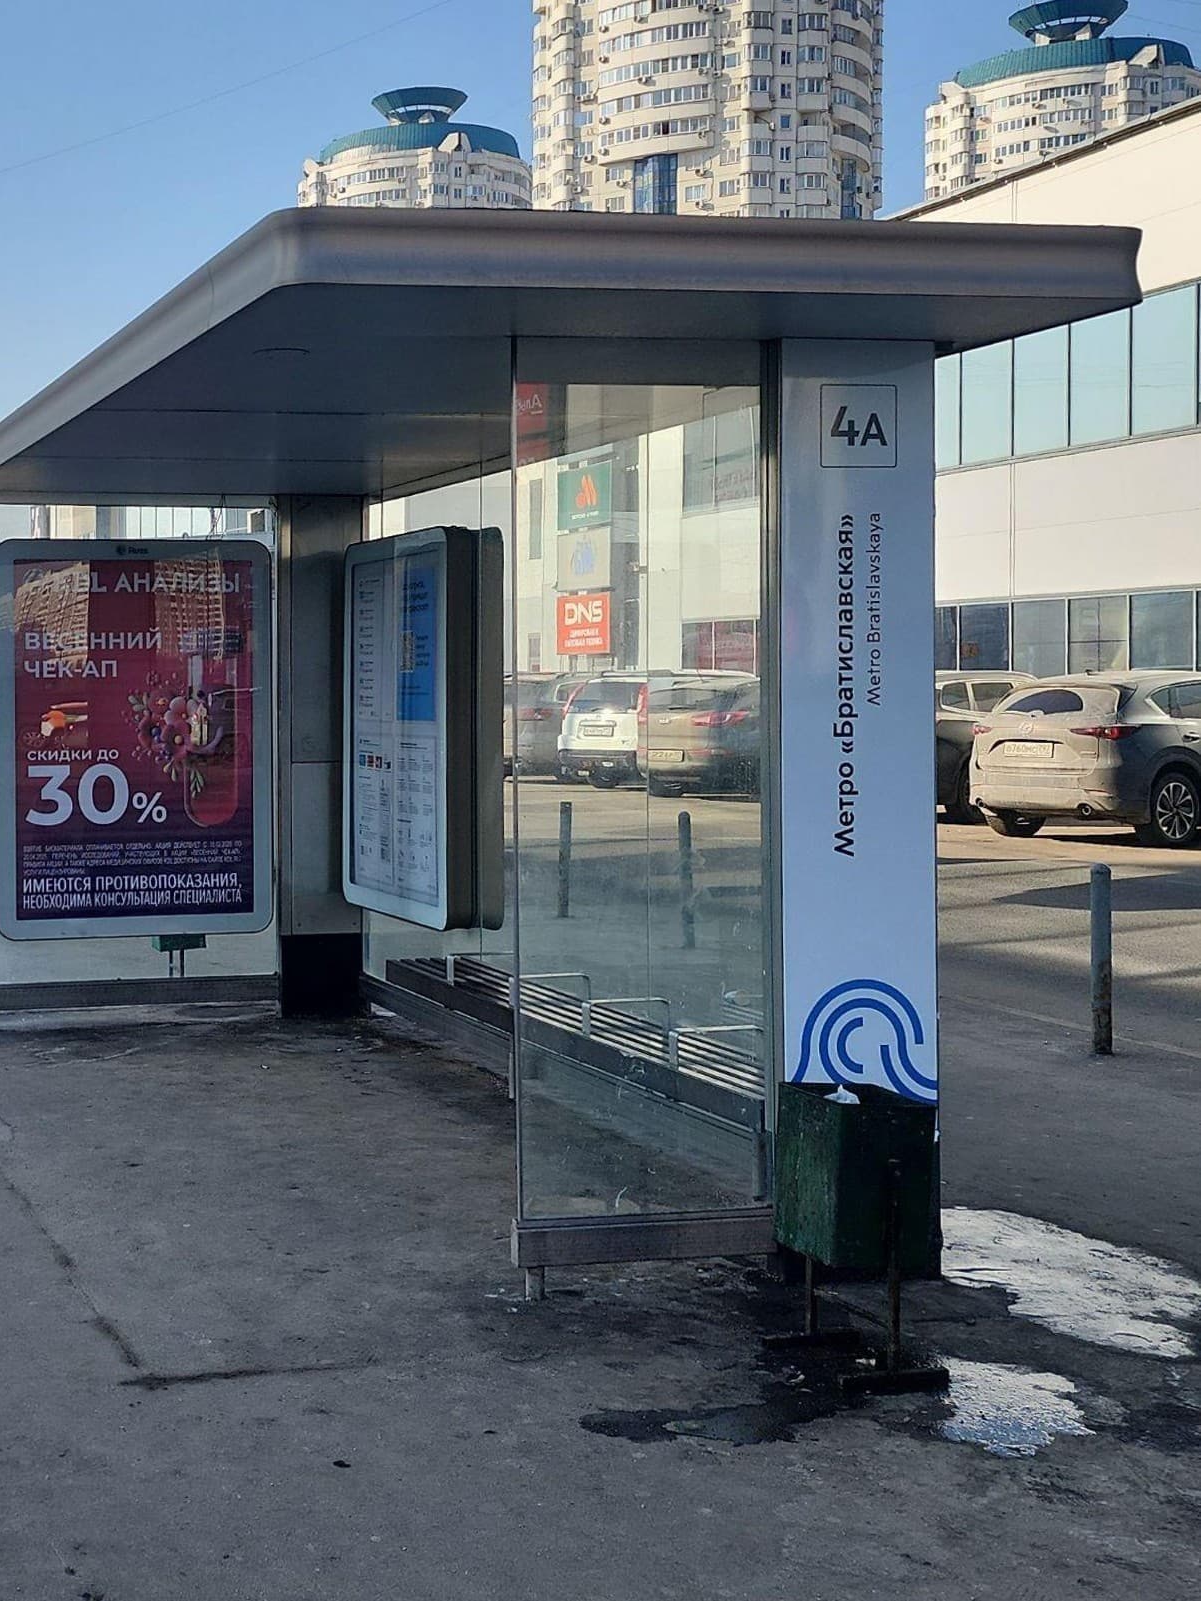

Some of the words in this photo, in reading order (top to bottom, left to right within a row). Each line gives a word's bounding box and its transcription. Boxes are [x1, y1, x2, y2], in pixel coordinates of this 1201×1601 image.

[829, 405, 888, 447] 4А
[114, 572, 240, 593] АНАЛИЗЫ
[865, 511, 884, 643] Bratislavskaya
[564, 600, 603, 625] DNS
[24, 626, 162, 650] ВЕСЕННИЙ
[832, 512, 859, 754] «Братиславская»
[24, 660, 118, 678] ЧЕК-АП
[865, 645, 882, 706] Metro
[27, 749, 92, 762] скидки
[96, 748, 119, 762] до
[25, 762, 168, 827] 30%
[833, 763, 858, 858] Метро
[23, 875, 92, 894] ИМЕЮТСЯ
[95, 871, 243, 891] ПРОТИВОПОКАЗАНИЯ,
[22, 893, 93, 911] НЕОБХОДИМА
[94, 890, 171, 907] КОНСУЛЬТАЦИЯ
[173, 888, 243, 905] СПЕЦИАЛИСТА
